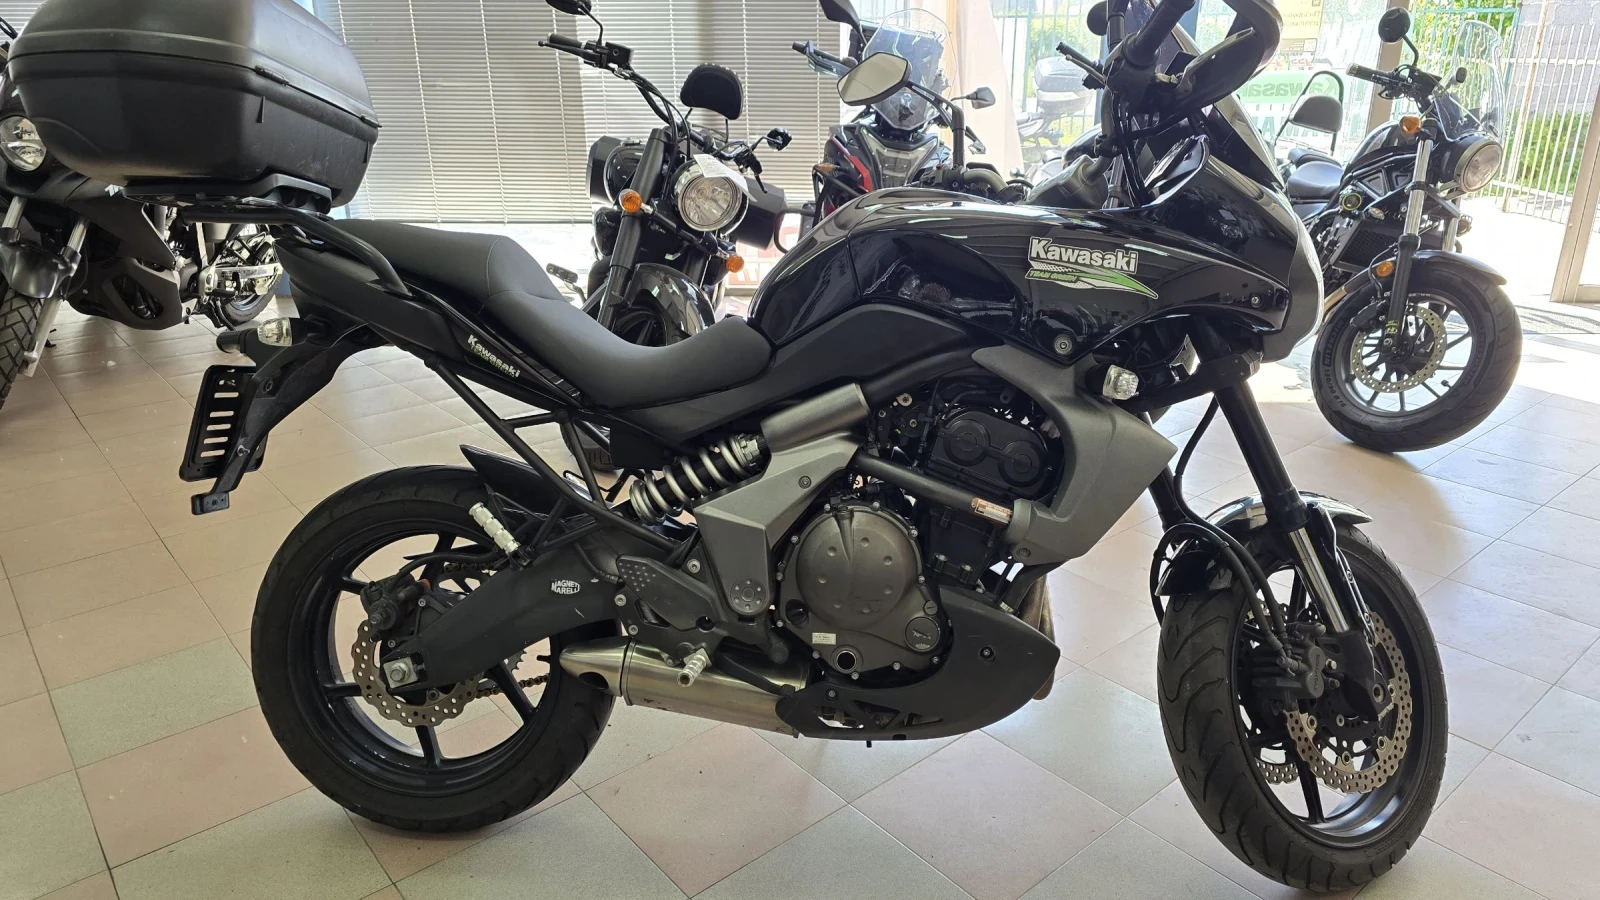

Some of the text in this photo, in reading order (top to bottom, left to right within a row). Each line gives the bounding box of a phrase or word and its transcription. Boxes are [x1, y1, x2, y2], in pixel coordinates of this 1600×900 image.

[1030, 237, 1138, 273] Kawasaki
[467, 334, 520, 377] Kawasaki
[1324, 318, 1344, 366] MICHELIN
